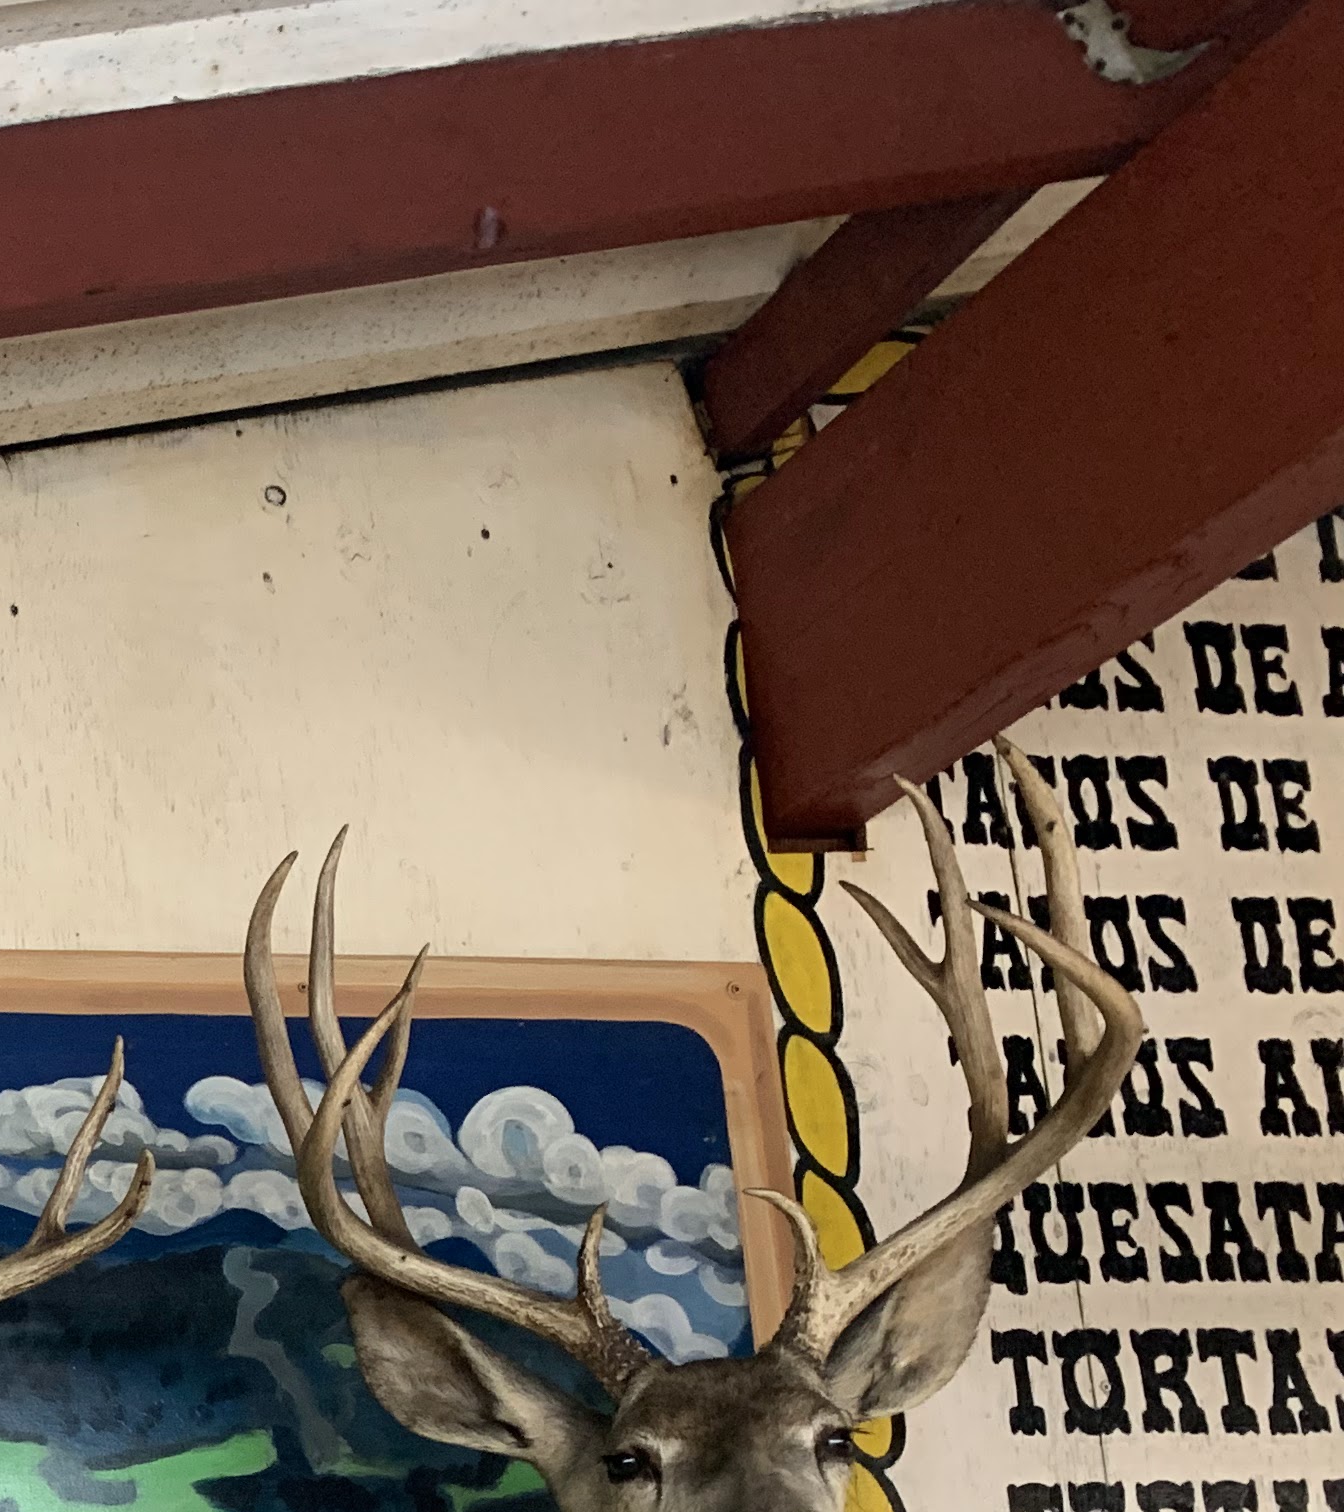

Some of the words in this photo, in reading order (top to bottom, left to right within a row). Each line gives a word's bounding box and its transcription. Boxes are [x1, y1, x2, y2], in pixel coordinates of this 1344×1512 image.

[1182, 620, 1303, 716] DE
[1207, 755, 1320, 853] DE
[928, 889, 1198, 993] AOS
[1233, 896, 1344, 993] DE
[948, 1035, 1227, 1138] AOS
